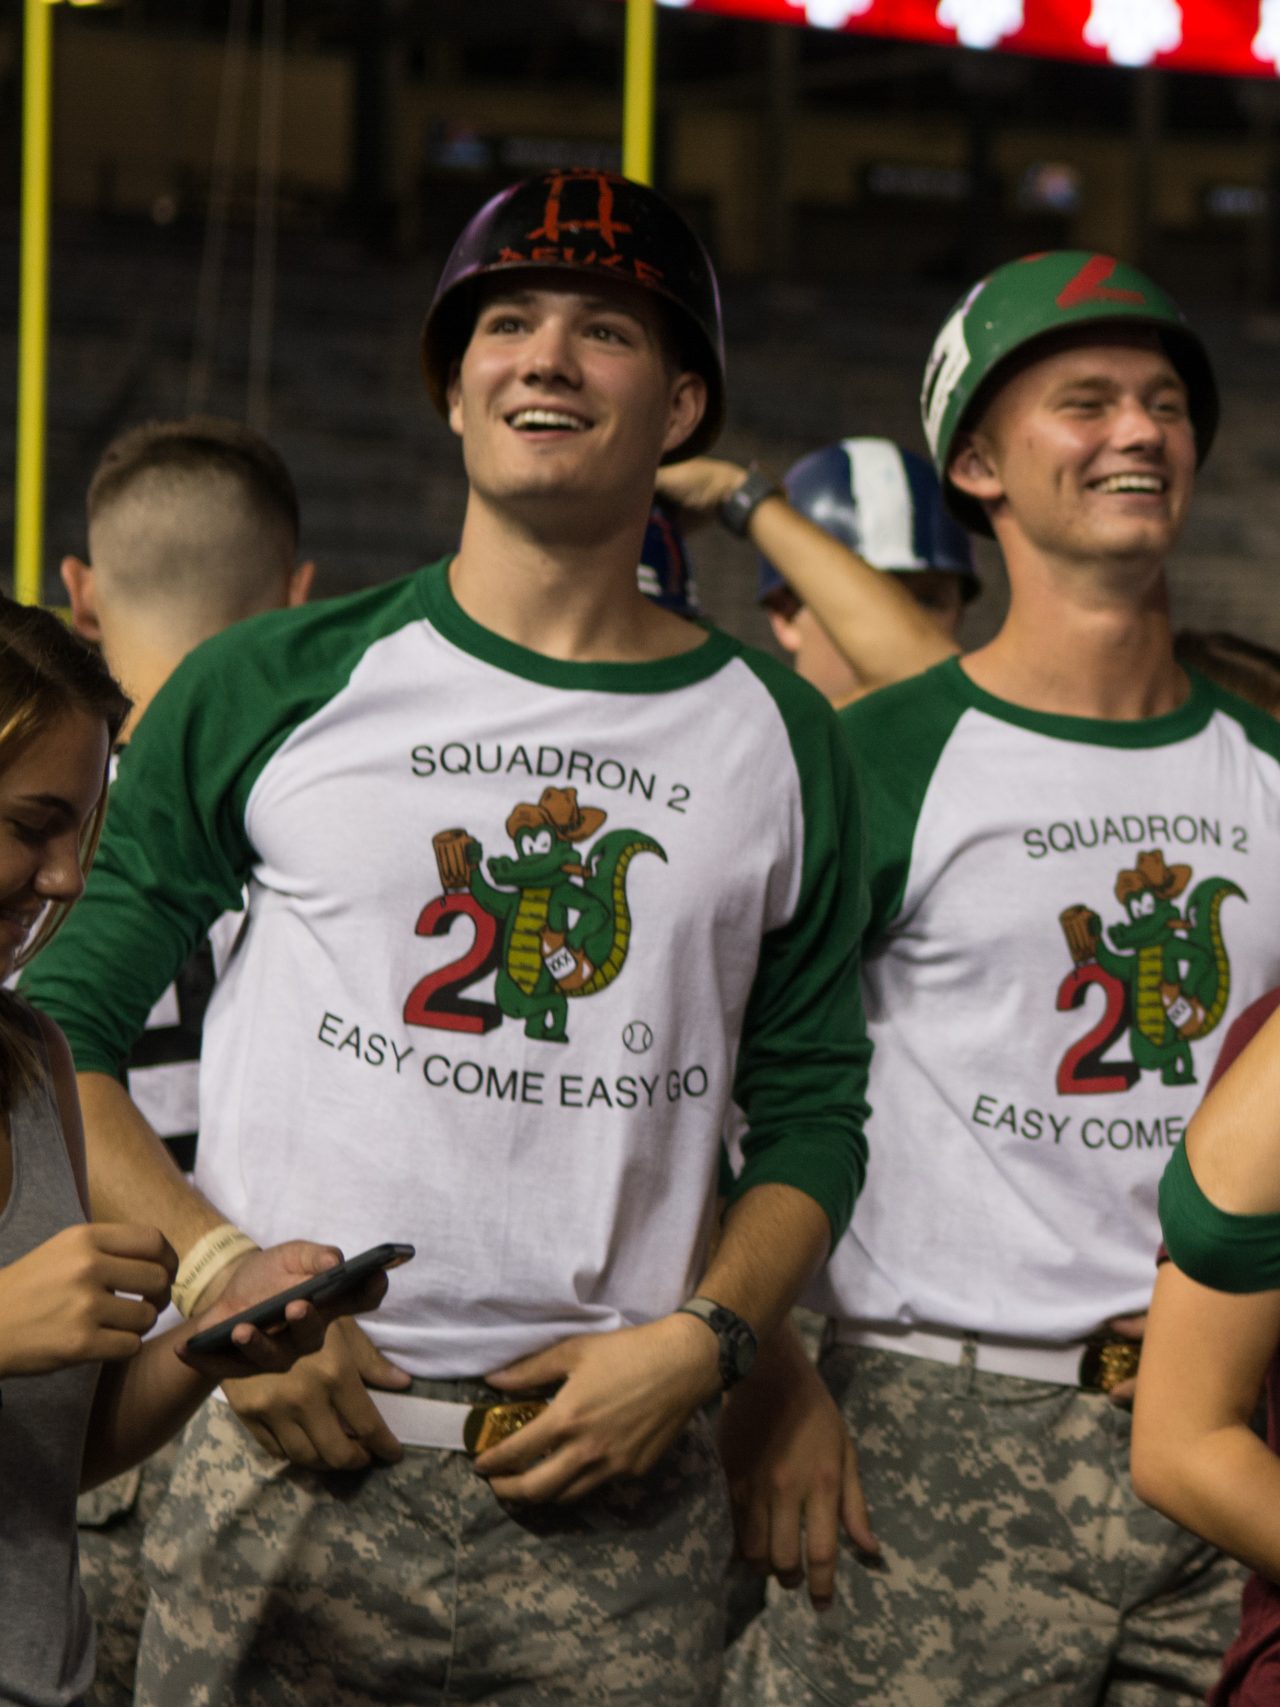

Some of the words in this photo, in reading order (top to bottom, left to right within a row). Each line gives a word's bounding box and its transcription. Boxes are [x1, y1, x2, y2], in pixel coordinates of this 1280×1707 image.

[411, 742, 656, 802] SQUADRON
[667, 783, 691, 814] 2
[1023, 815, 1221, 859] SQUADRON
[1231, 826, 1249, 854] 2
[403, 893, 502, 1034] 2
[317, 1011, 414, 1074] EASY
[423, 1054, 544, 1105] COME
[560, 1073, 659, 1109] EASY
[666, 1065, 708, 1101] GO
[1056, 963, 1142, 1096] 2
[972, 1094, 1071, 1144] EASY
[1081, 1116, 1185, 1150] COME
